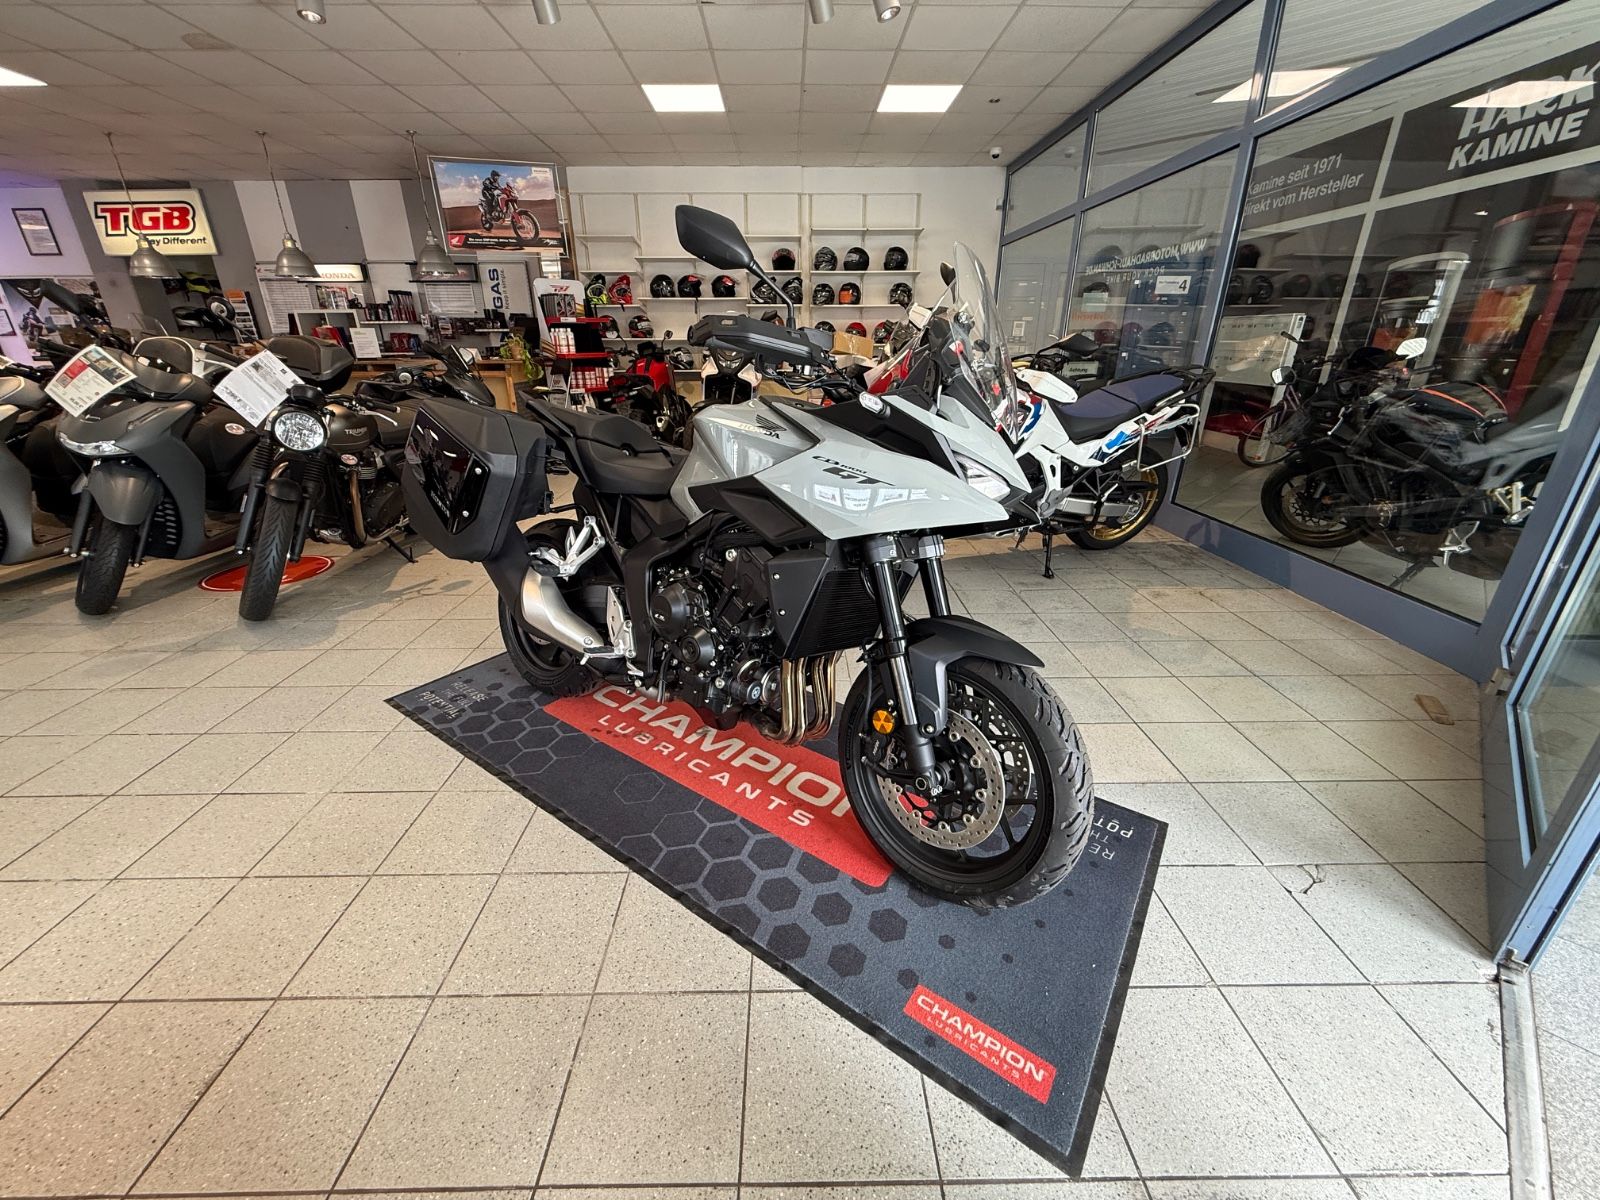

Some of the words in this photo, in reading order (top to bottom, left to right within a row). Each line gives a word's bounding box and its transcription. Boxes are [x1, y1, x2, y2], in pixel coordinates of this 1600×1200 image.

[1447, 108, 1590, 171] KAMINE
[1286, 164, 1311, 184] seit
[1312, 152, 1343, 177] 1971
[1272, 191, 1297, 209] vom
[1298, 173, 1365, 202] Hersteller
[96, 202, 195, 236] TGB
[162, 236, 207, 245] Different
[1178, 278, 1188, 292] 4
[822, 466, 896, 487] GT
[592, 685, 851, 818] CHAMPIO
[598, 714, 815, 827] LUBRICANTS
[917, 994, 1045, 1082] CHAMPION
[926, 1015, 1020, 1079] LUBRICANTS
